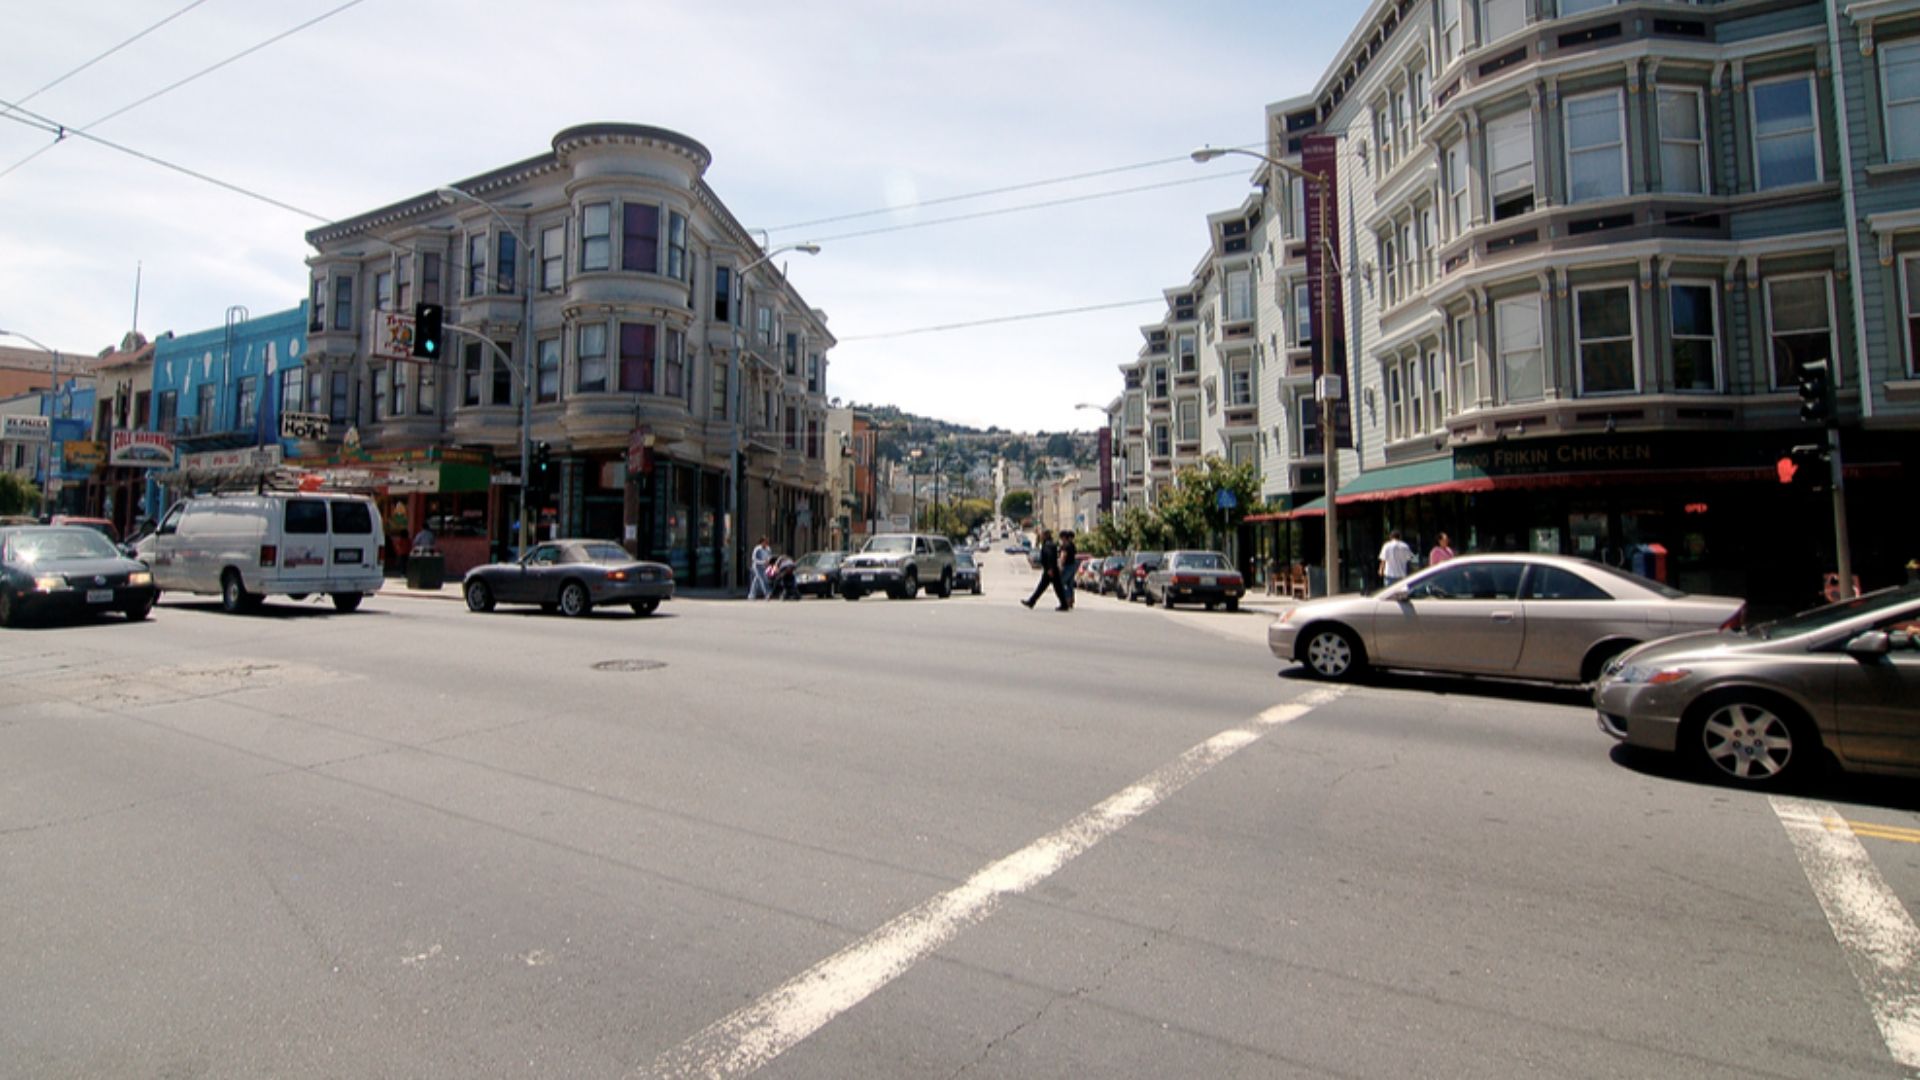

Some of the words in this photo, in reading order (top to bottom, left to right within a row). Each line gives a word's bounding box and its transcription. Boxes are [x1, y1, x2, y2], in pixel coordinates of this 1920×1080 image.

[285, 421, 329, 439] HOTEL
[114, 431, 132, 451] COLE
[1494, 450, 1549, 467] FRIKIN
[1556, 444, 1651, 463] CHICKEN
[1684, 503, 1708, 513] OPEN
